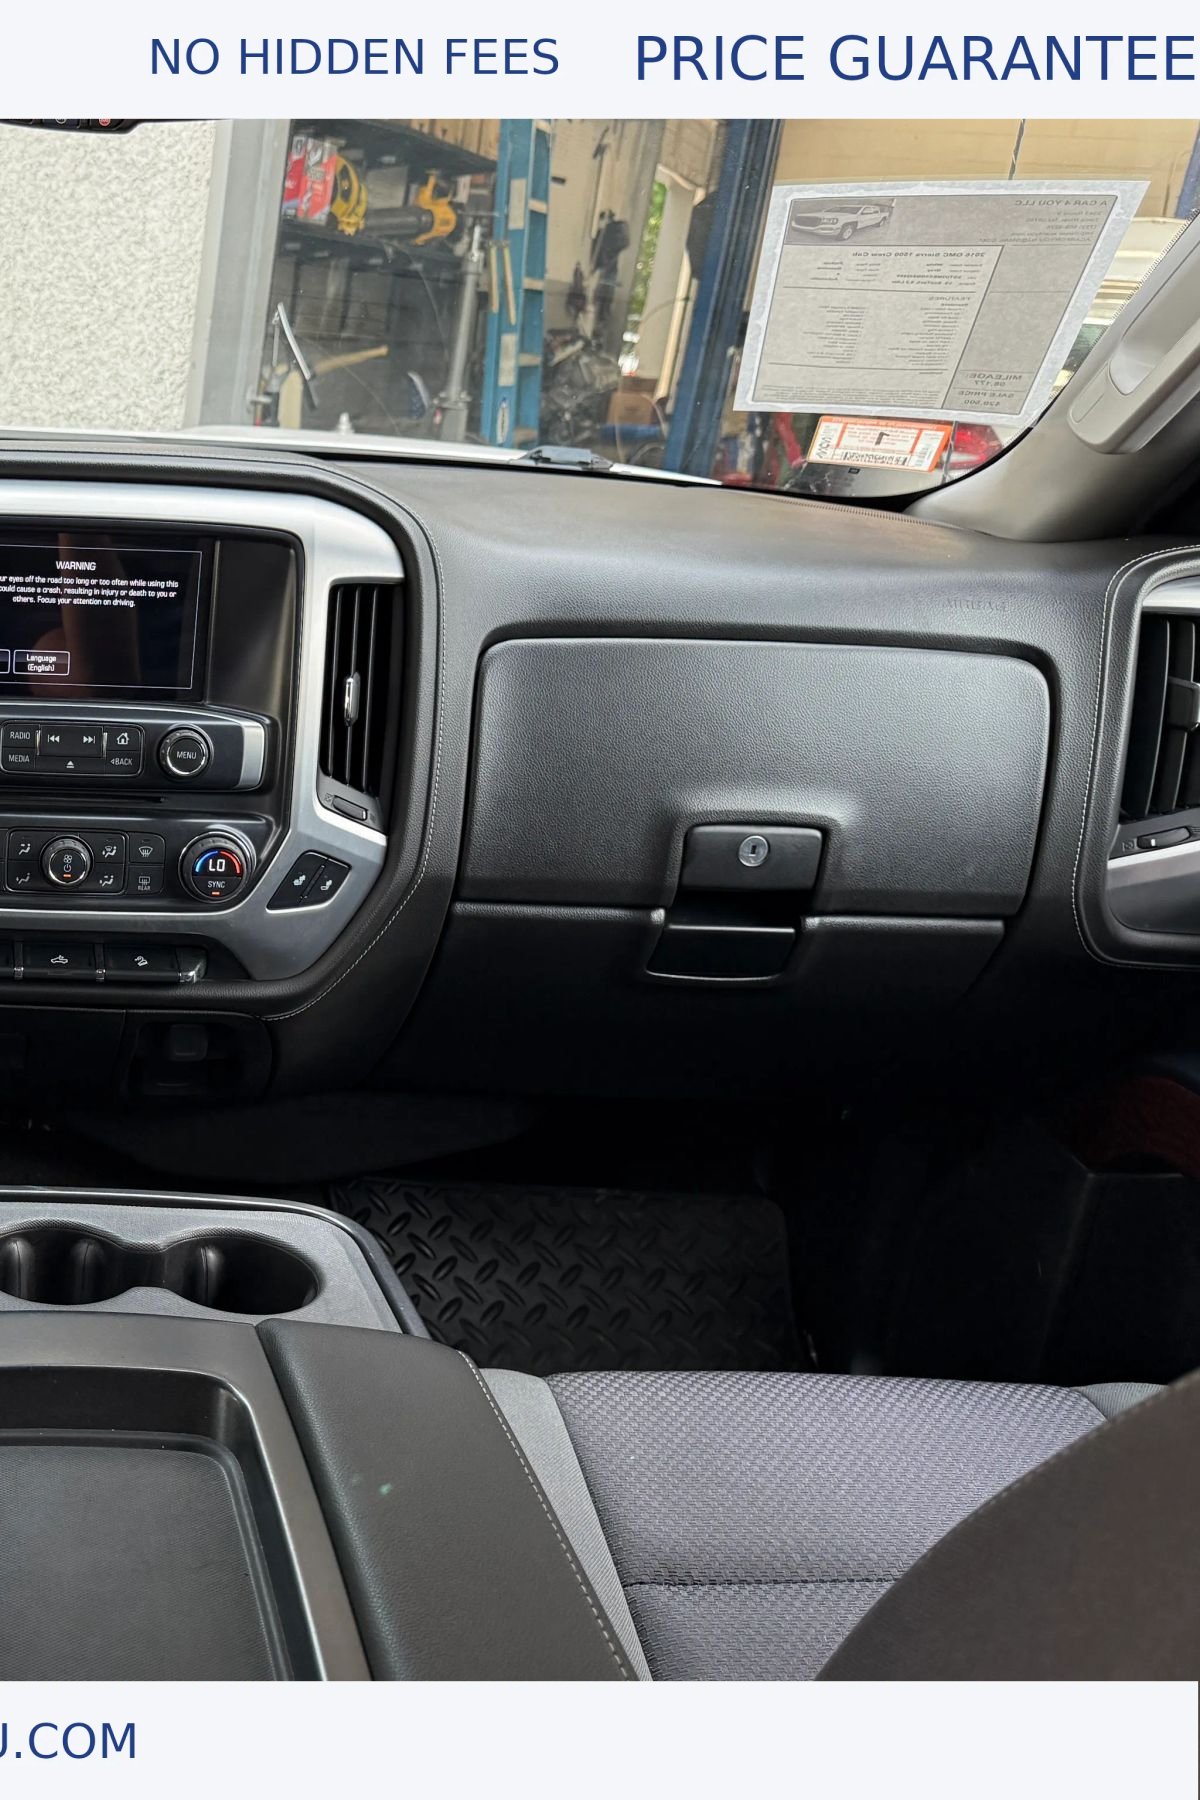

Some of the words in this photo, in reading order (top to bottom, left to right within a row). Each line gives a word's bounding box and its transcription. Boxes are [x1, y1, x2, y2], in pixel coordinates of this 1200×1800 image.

[55, 561, 97, 571] WARNING
[47, 576, 63, 584] road
[76, 577, 90, 586] long
[111, 578, 128, 586] often
[130, 579, 146, 587] while
[147, 580, 165, 589] using
[166, 580, 179, 588] this
[42, 586, 63, 594] crash,
[63, 588, 93, 596] resulting
[101, 588, 119, 597] injury
[128, 589, 147, 597] death
[12, 595, 36, 603] others.
[37, 595, 56, 604] Focus
[57, 597, 72, 605] your
[112, 599, 136, 608] driving.
[26, 654, 57, 664] Language
[27, 664, 55, 673] (English)
[10, 731, 31, 741] RADIO
[8, 754, 30, 763] MEDIA
[176, 751, 197, 760] MENU
[115, 757, 133, 766] BACK
[208, 859, 226, 872] LO
[207, 880, 226, 889] SYNC
